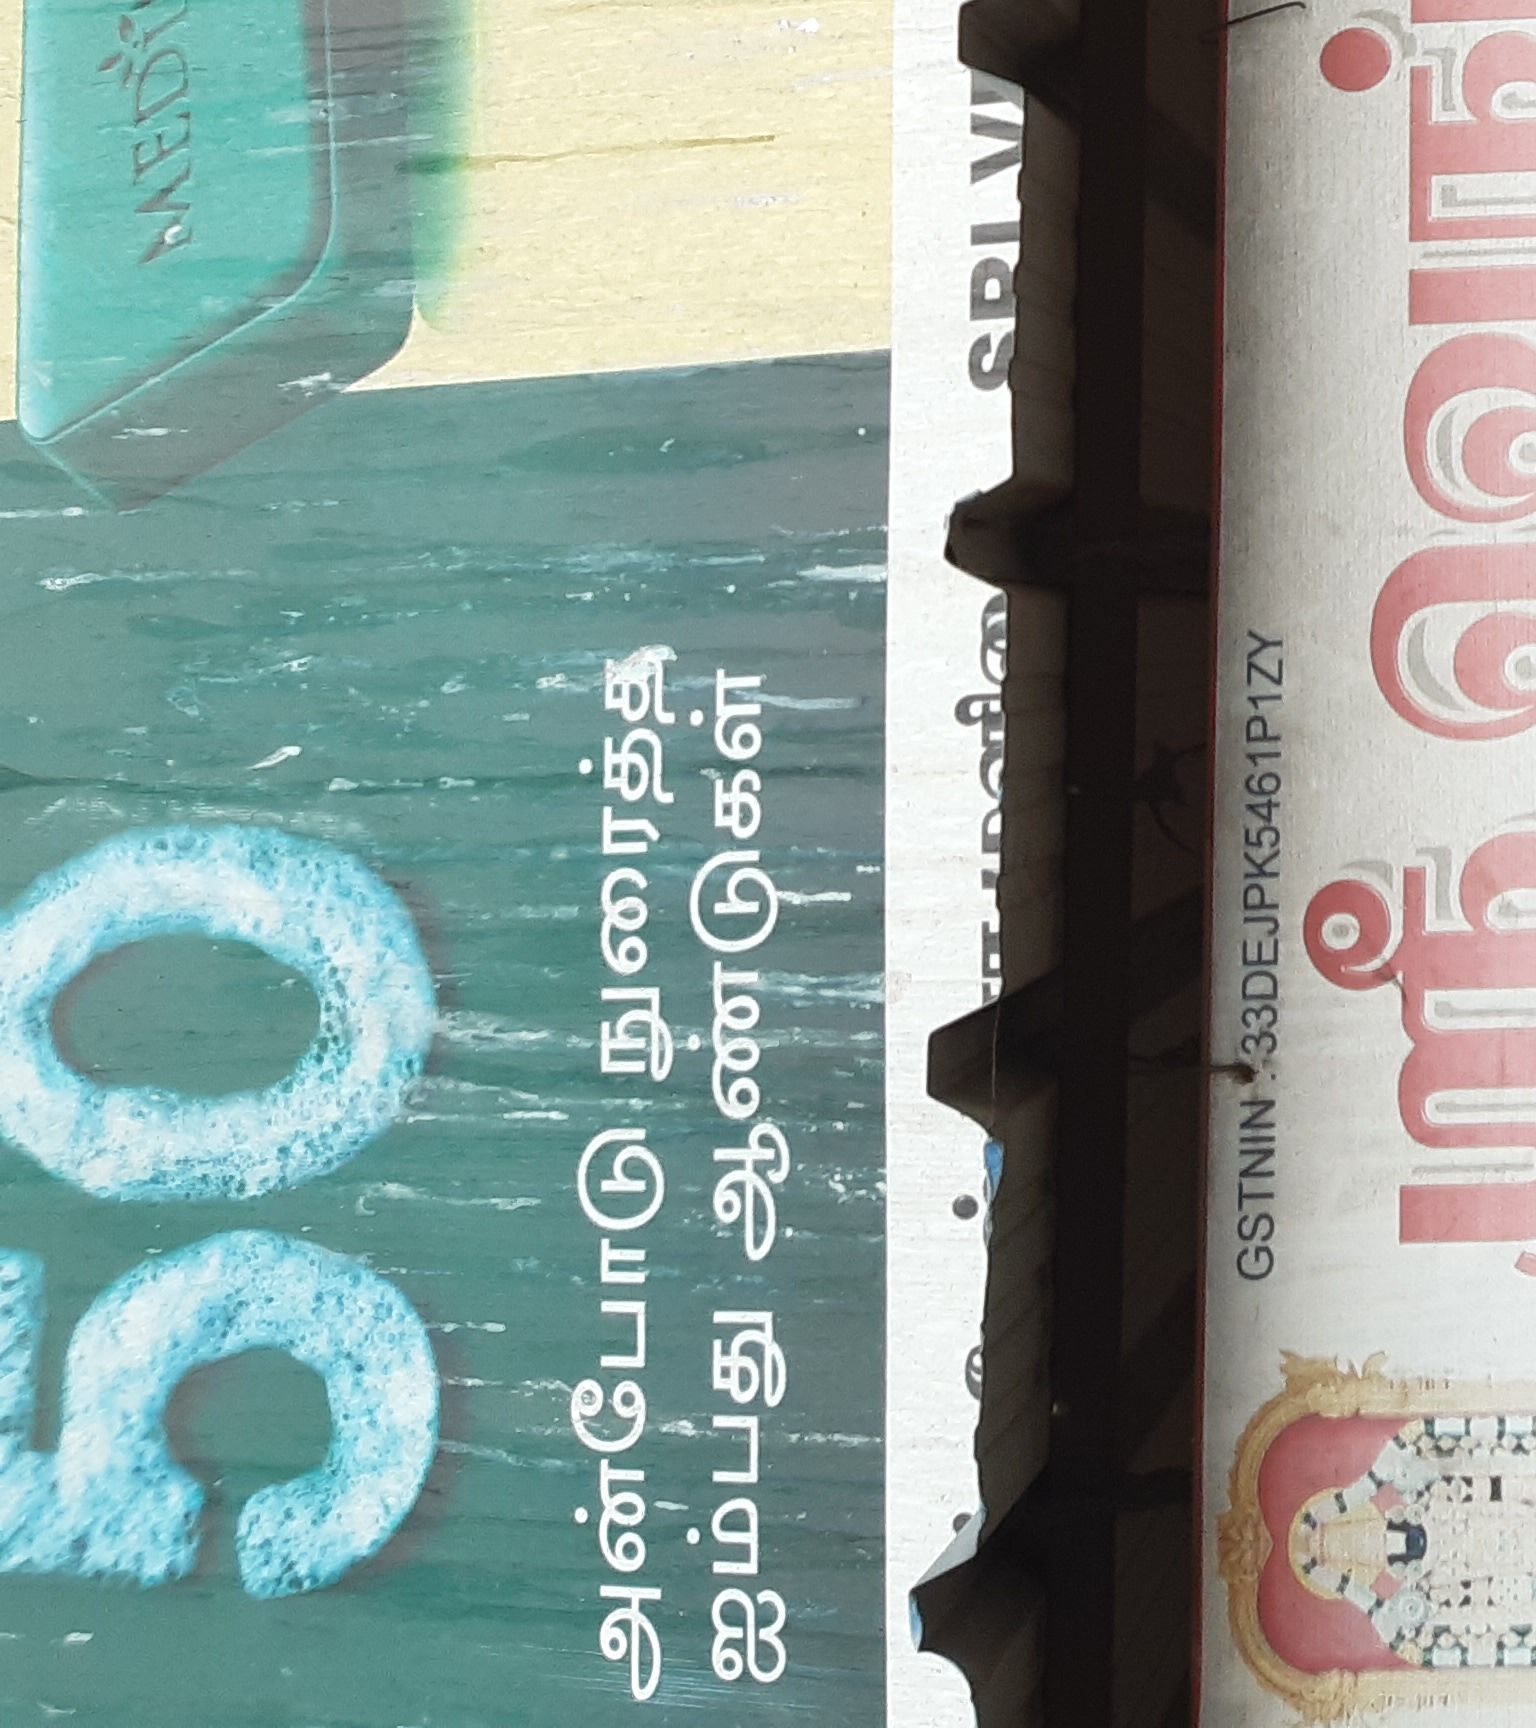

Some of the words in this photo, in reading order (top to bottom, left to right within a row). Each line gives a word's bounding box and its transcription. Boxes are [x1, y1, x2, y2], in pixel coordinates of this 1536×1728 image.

[579, 660, 677, 1075] நுரைத்த
[689, 668, 790, 1261] ஆண்டுகள்
[1240, 628, 1285, 1055] 33DEJPK5461P1ZY
[0, 823, 438, 1599] 50
[1236, 1099, 1278, 1281] GSTNIN
[570, 1128, 663, 1700] அன்போடு
[686, 1311, 786, 1683] ஐம்பது
